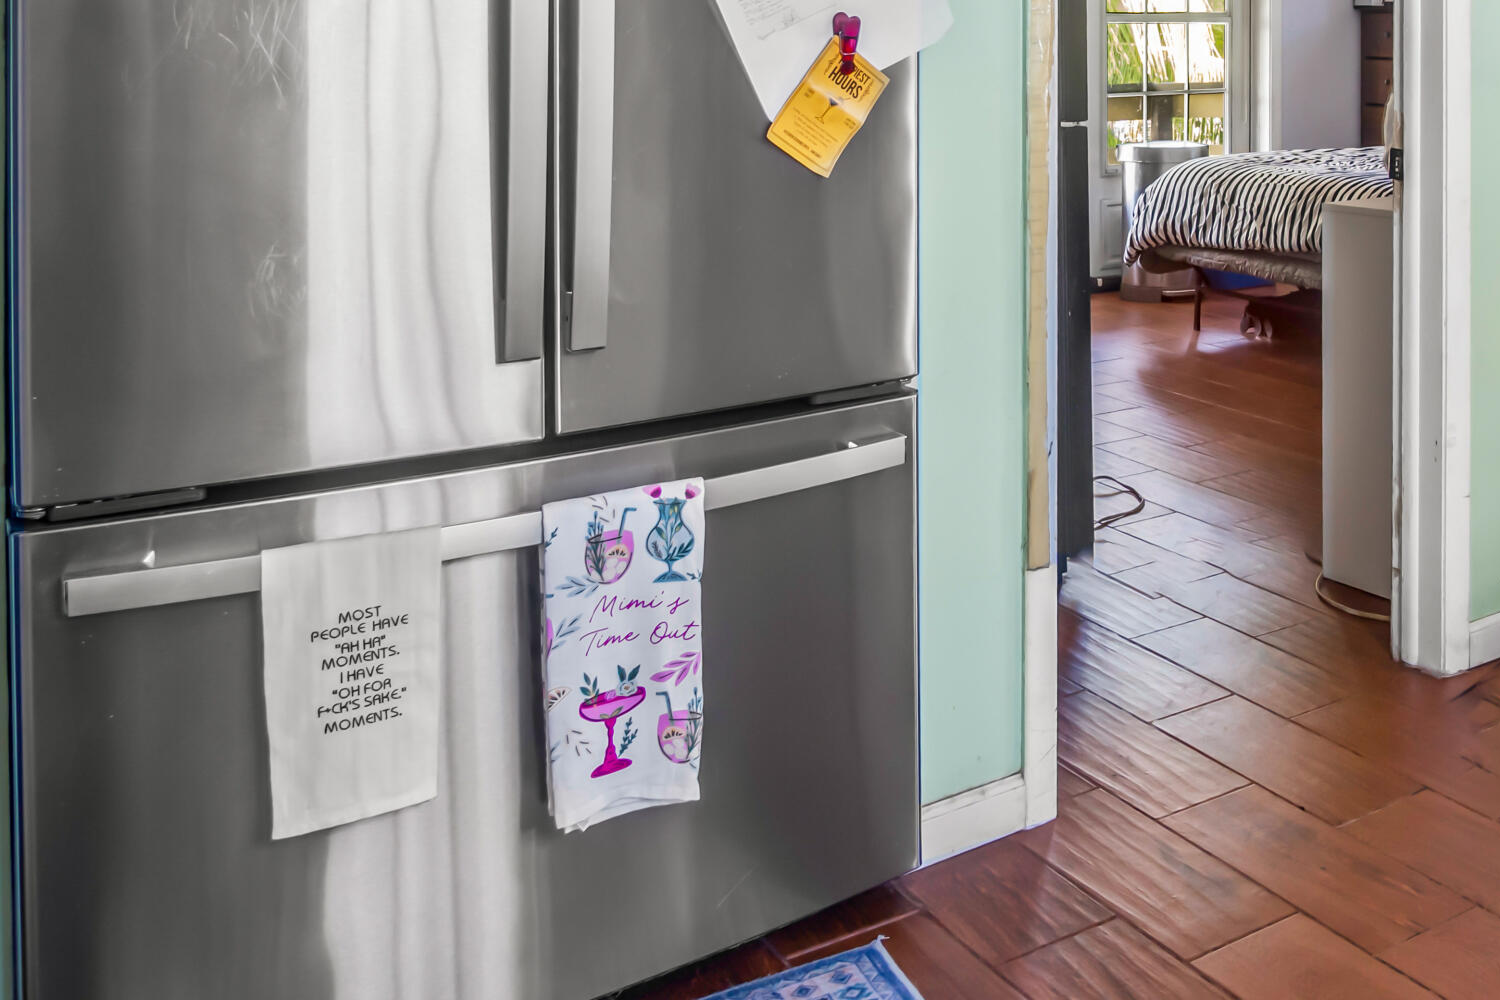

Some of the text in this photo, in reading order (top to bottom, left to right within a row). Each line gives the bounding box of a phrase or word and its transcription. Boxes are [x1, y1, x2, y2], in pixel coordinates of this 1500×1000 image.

[828, 66, 863, 99] HOURS
[338, 605, 382, 624] MOST
[589, 590, 690, 623] Mimi's
[310, 613, 409, 643] PEOPLE HAVE
[579, 620, 700, 656] Time Out
[335, 634, 386, 654] "AH HA"
[321, 645, 400, 671] MOMENTS.
[340, 663, 385, 684] I HAVE
[332, 678, 392, 699] "OH FOR
[324, 706, 403, 735] MOMENTS.
